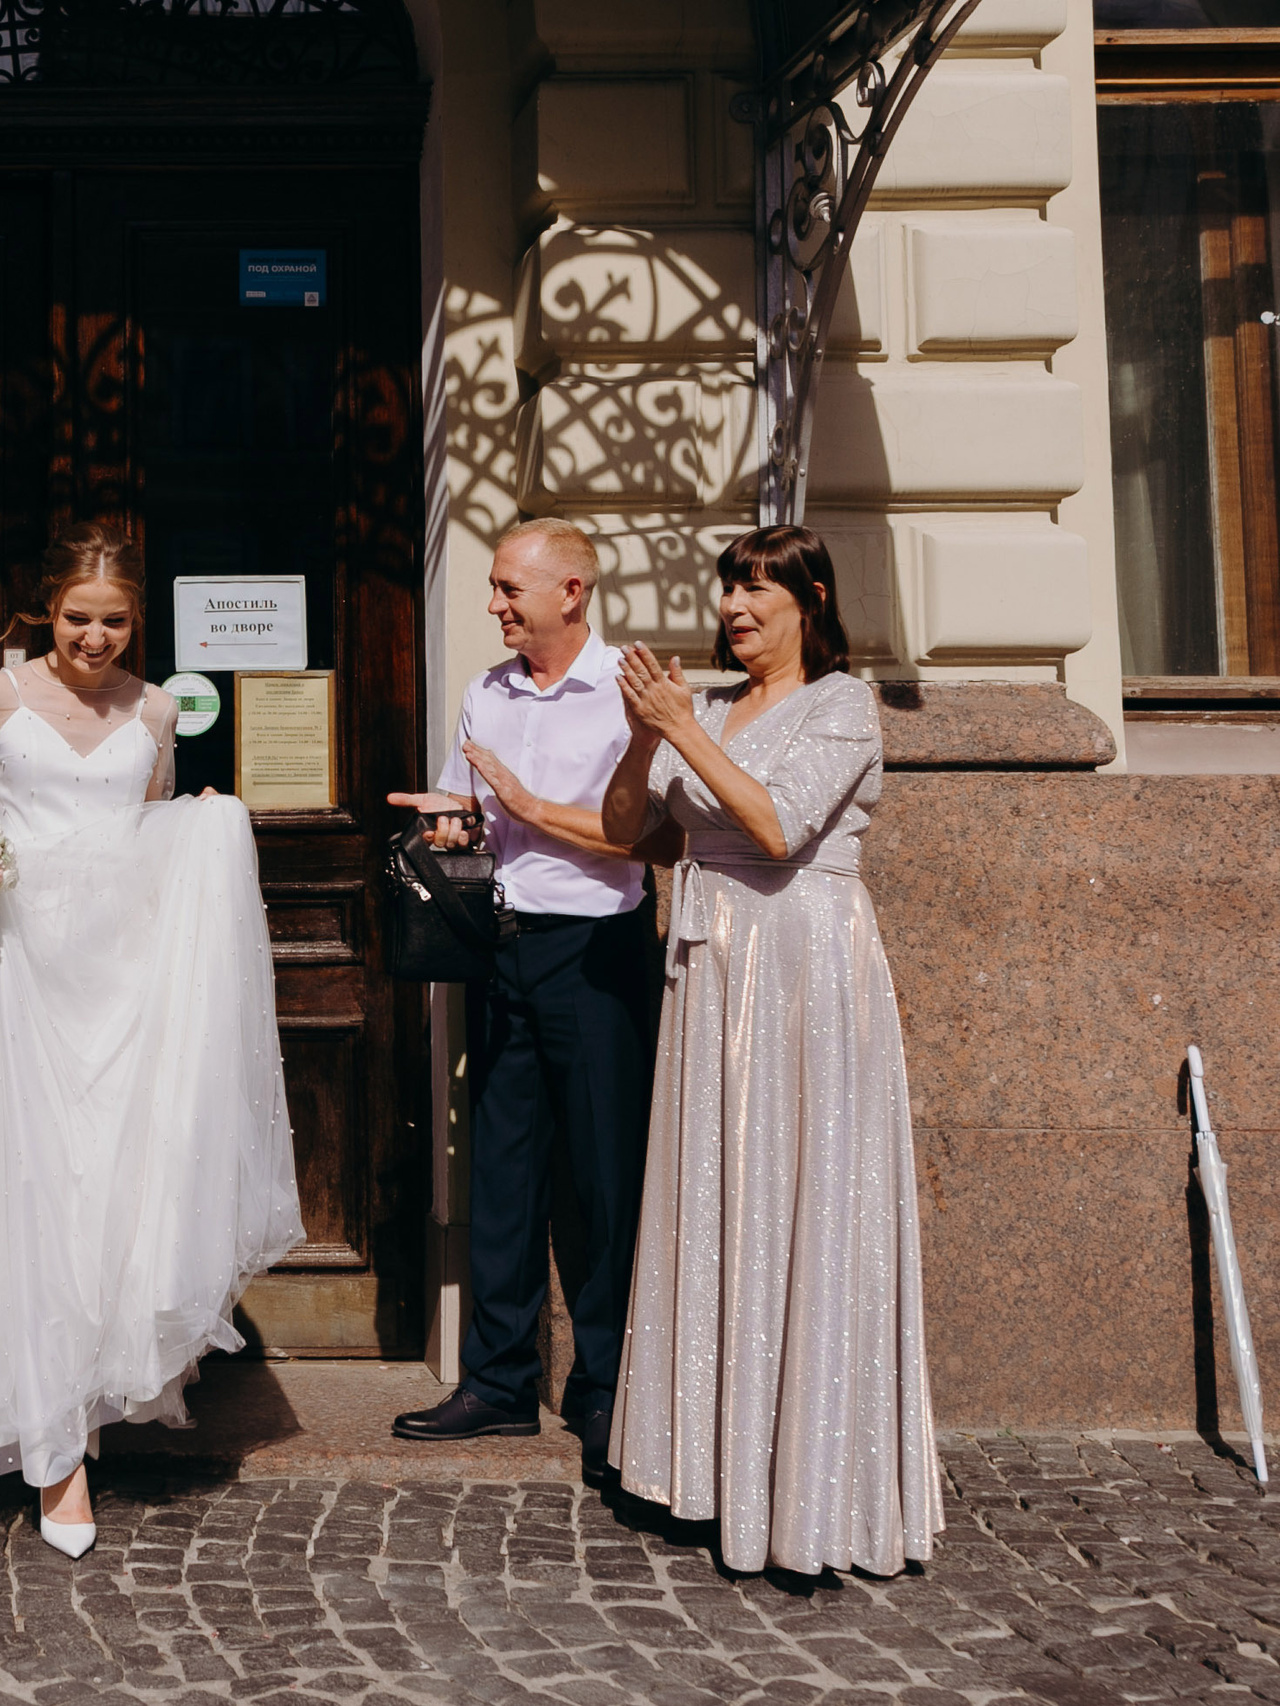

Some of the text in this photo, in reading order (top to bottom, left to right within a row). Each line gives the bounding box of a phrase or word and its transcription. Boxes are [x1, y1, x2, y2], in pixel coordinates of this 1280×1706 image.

[248, 264, 317, 274] ПОД ОХРАНОЙ
[204, 598, 278, 610] Апостиль
[210, 622, 274, 635] во дворе
